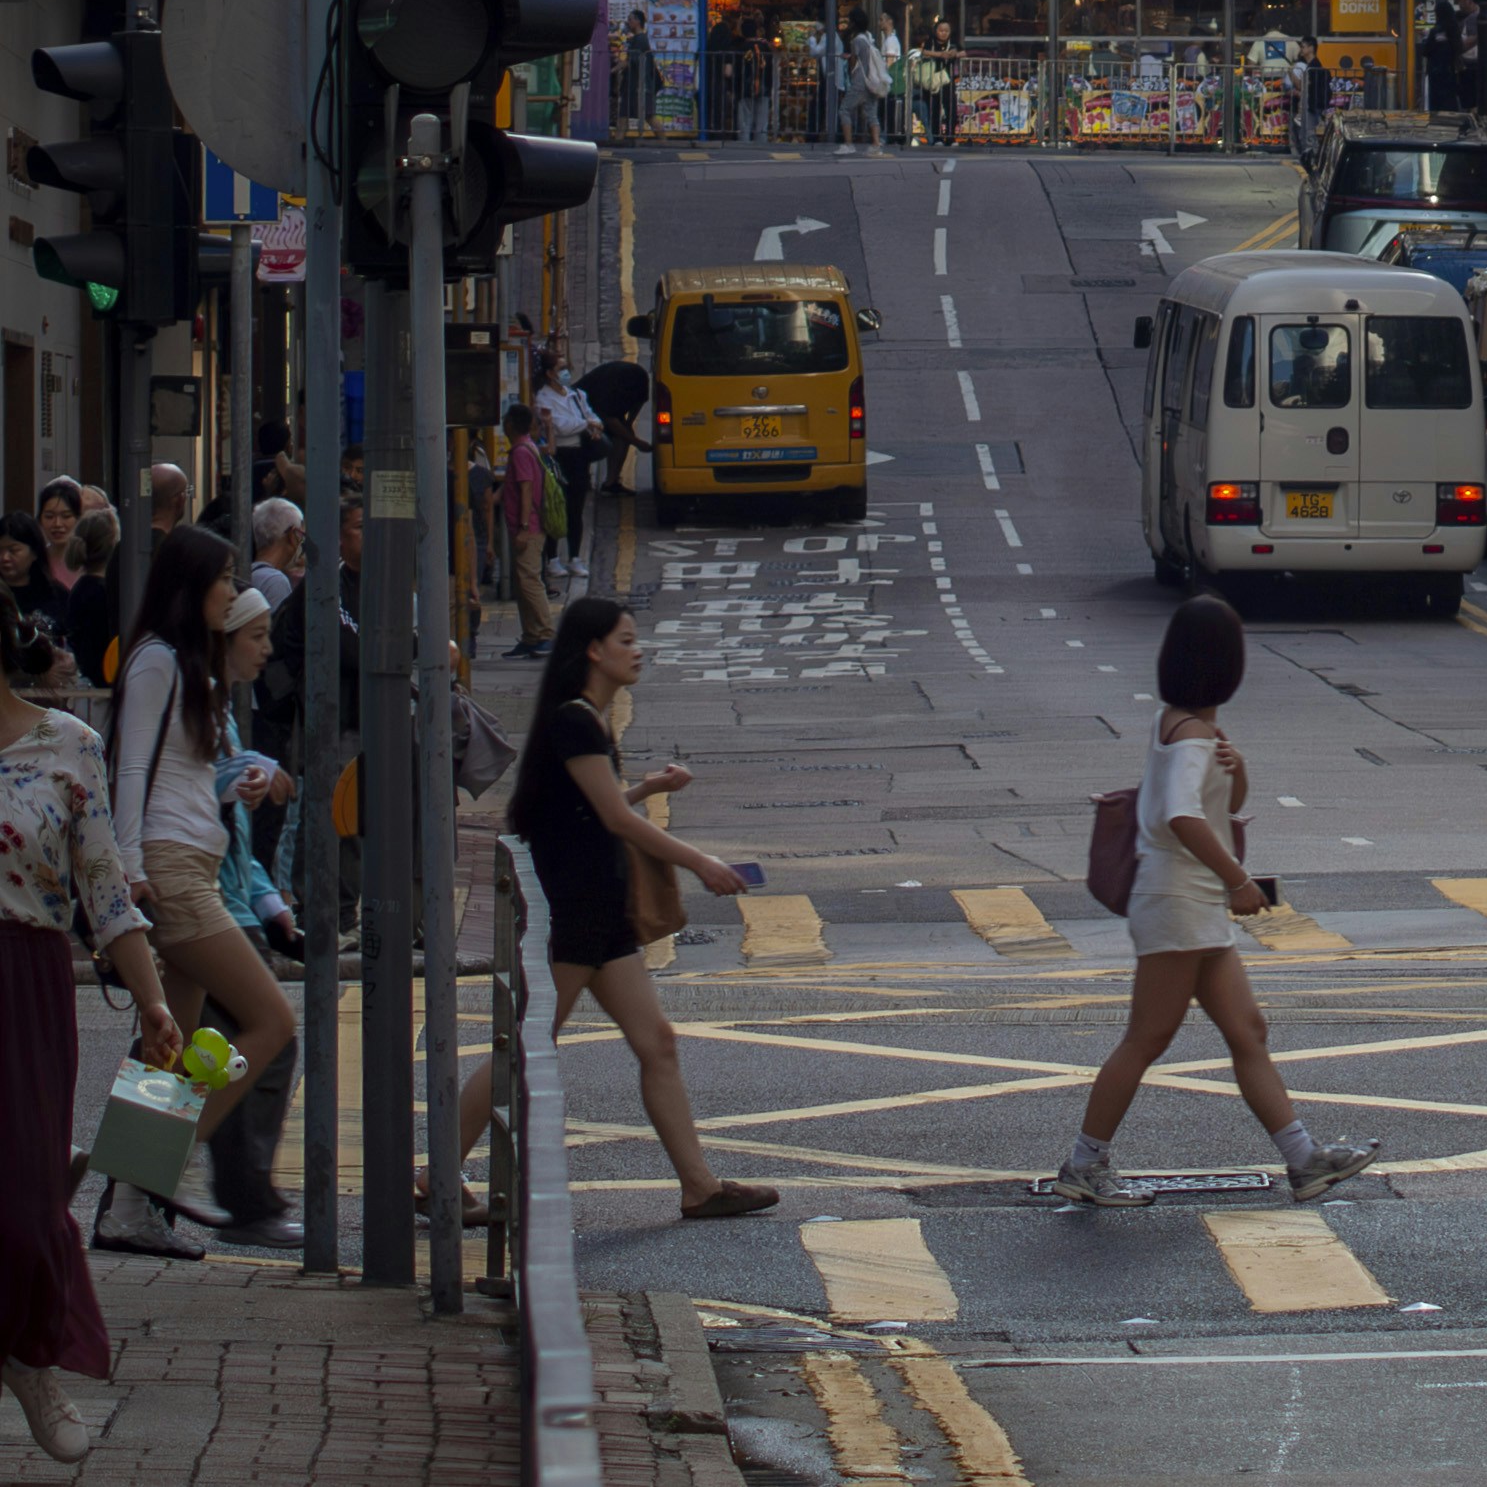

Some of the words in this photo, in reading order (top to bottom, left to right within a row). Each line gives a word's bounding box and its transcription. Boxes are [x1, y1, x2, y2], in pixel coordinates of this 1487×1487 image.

[743, 427, 780, 438] 9266
[1300, 493, 1320, 505] TG
[1290, 505, 1330, 518] 4628
[648, 534, 916, 557] STOP
[654, 614, 894, 635] BUS
